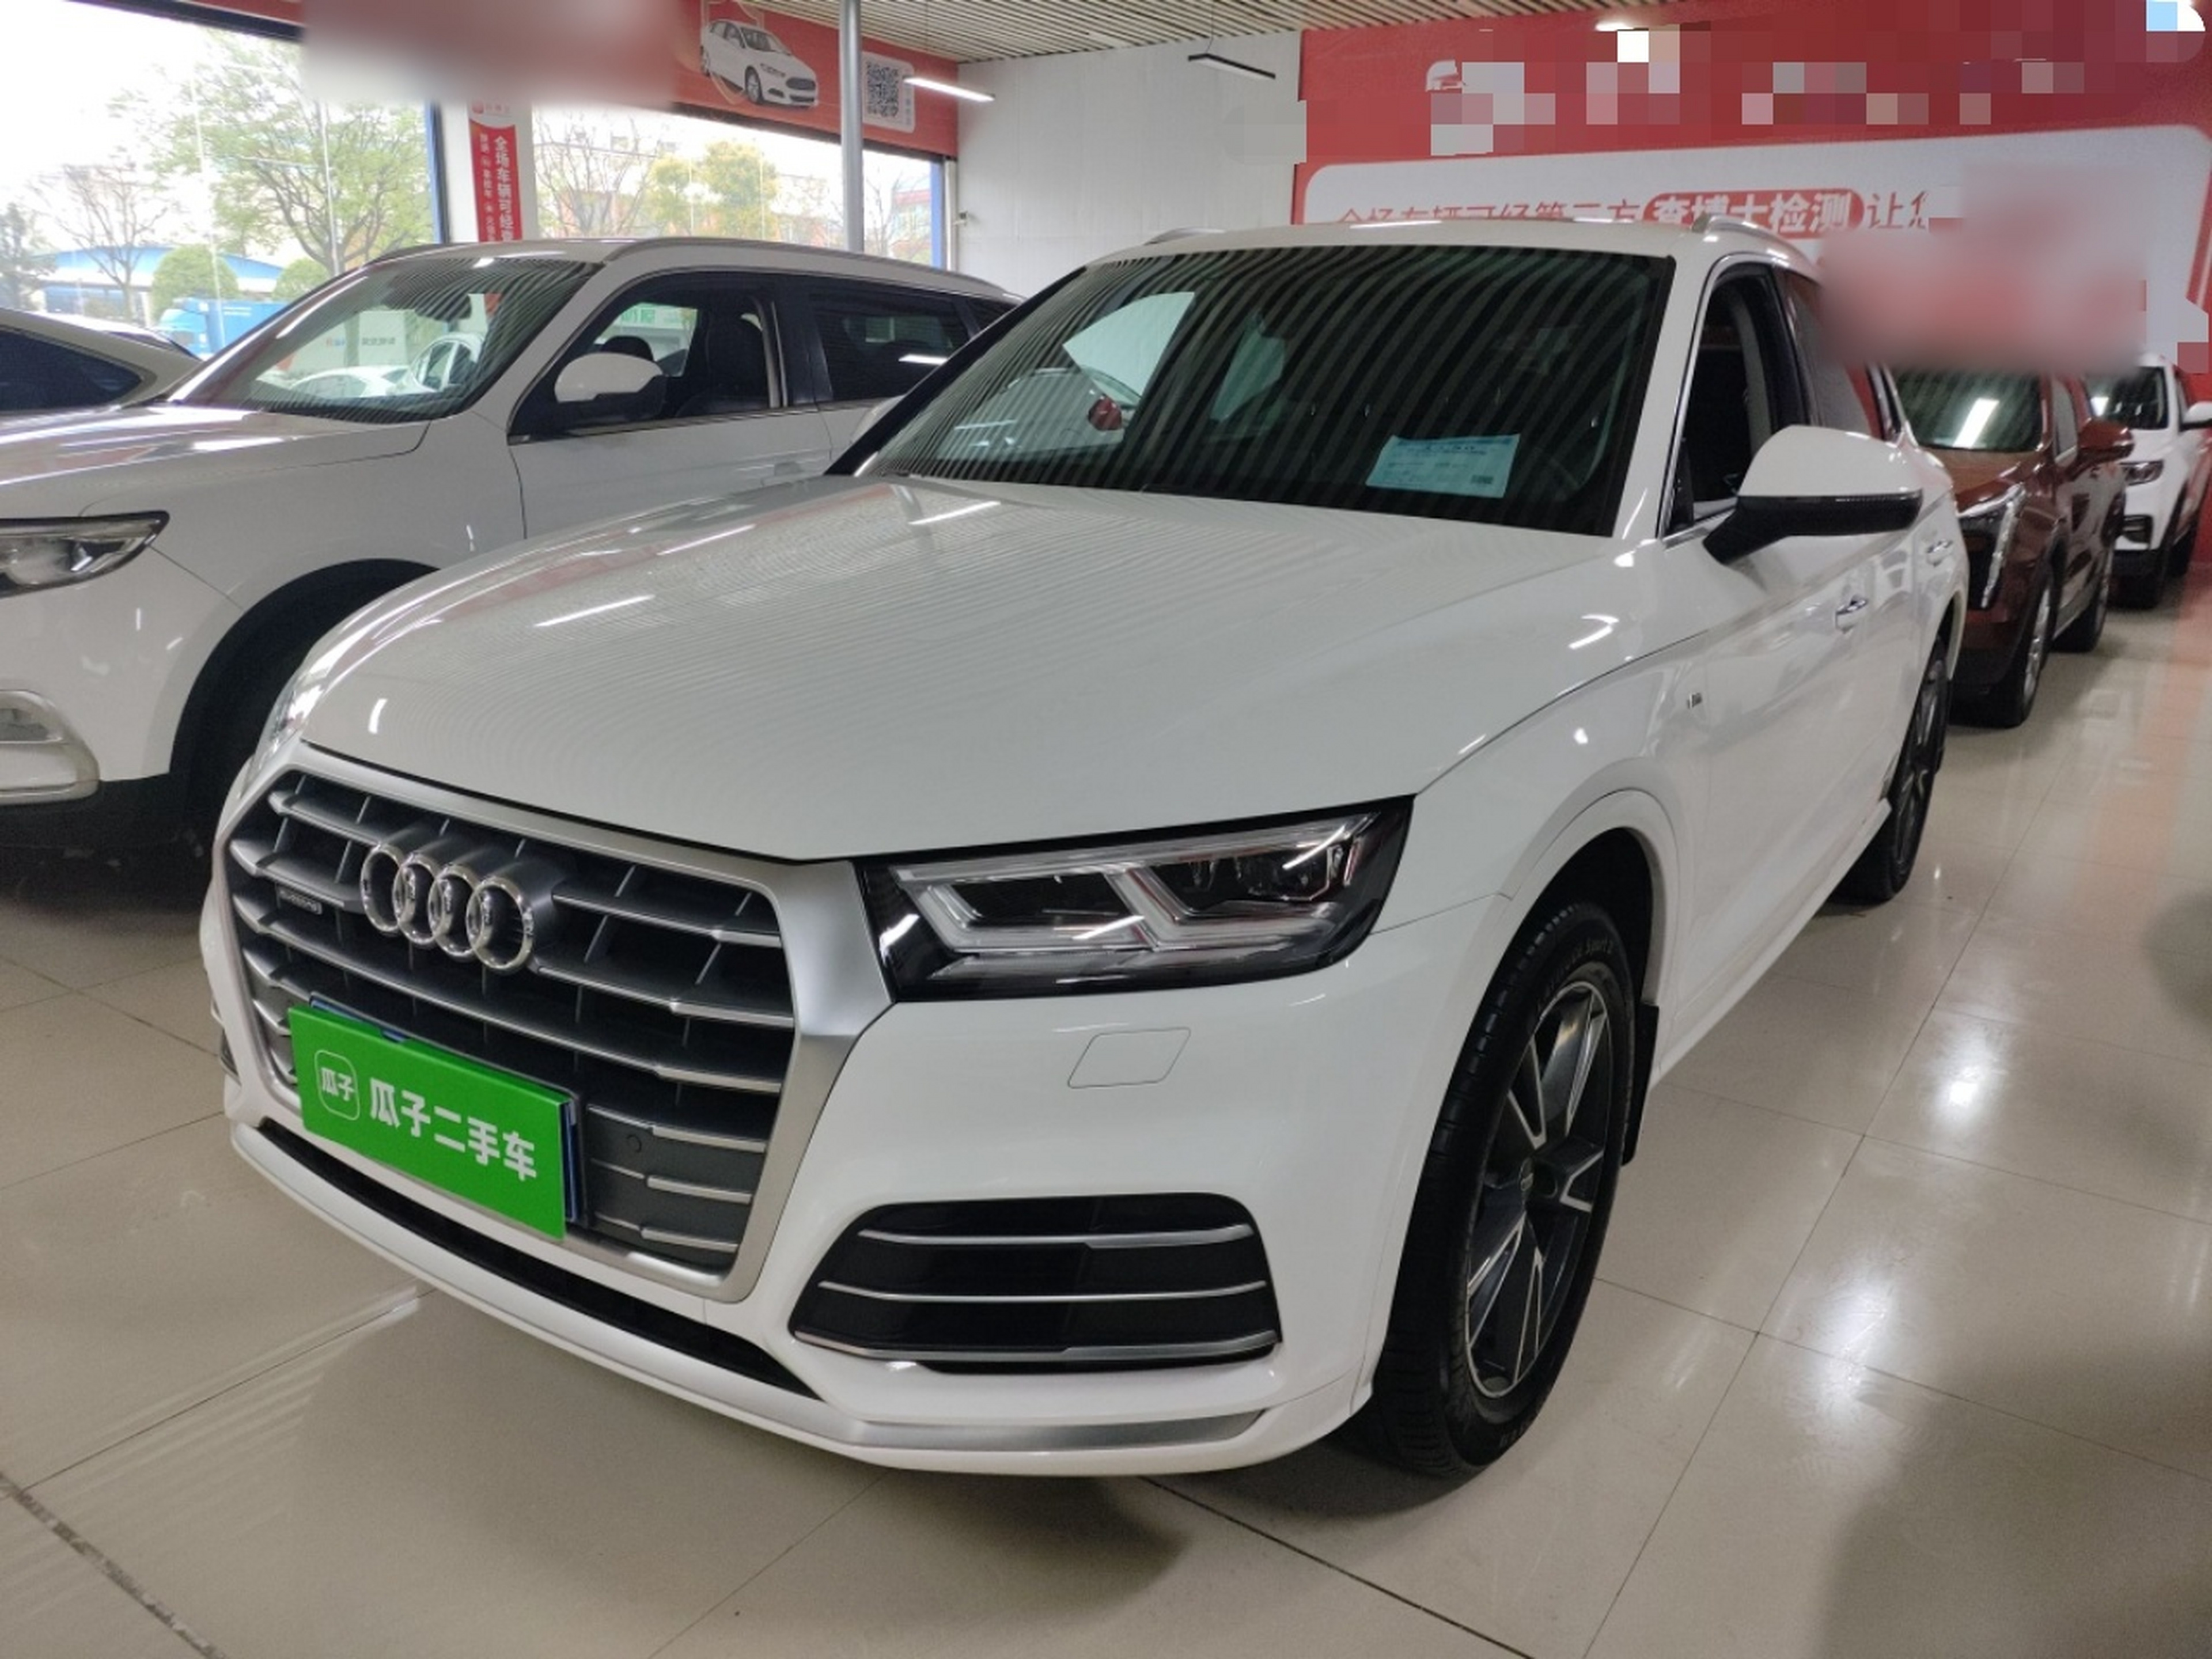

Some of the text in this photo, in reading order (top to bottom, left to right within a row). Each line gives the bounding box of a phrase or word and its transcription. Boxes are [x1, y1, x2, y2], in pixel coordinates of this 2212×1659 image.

[320, 1067, 536, 1182] 瓜子 瓜子二手车
